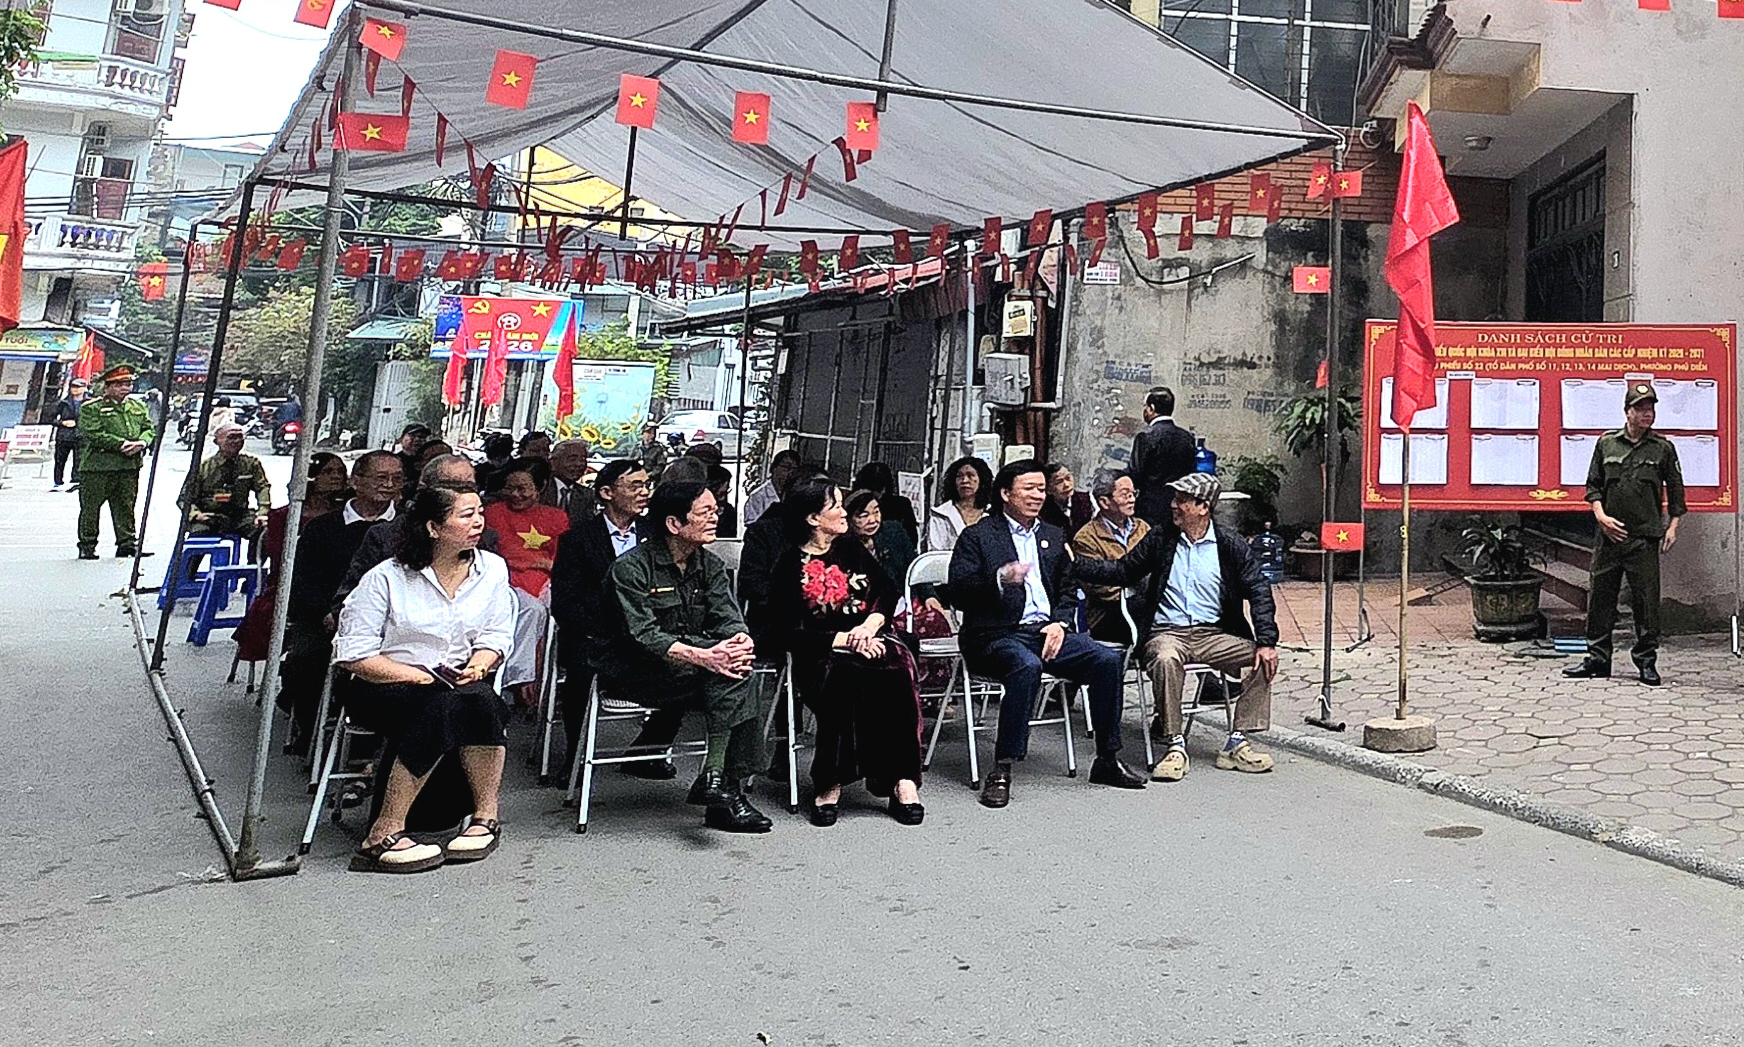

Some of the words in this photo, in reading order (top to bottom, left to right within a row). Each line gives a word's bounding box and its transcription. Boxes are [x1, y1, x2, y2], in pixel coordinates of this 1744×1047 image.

[1478, 334, 1520, 343] DANH
[1525, 331, 1566, 343] SÁCH
[1596, 334, 1622, 343] TRI
